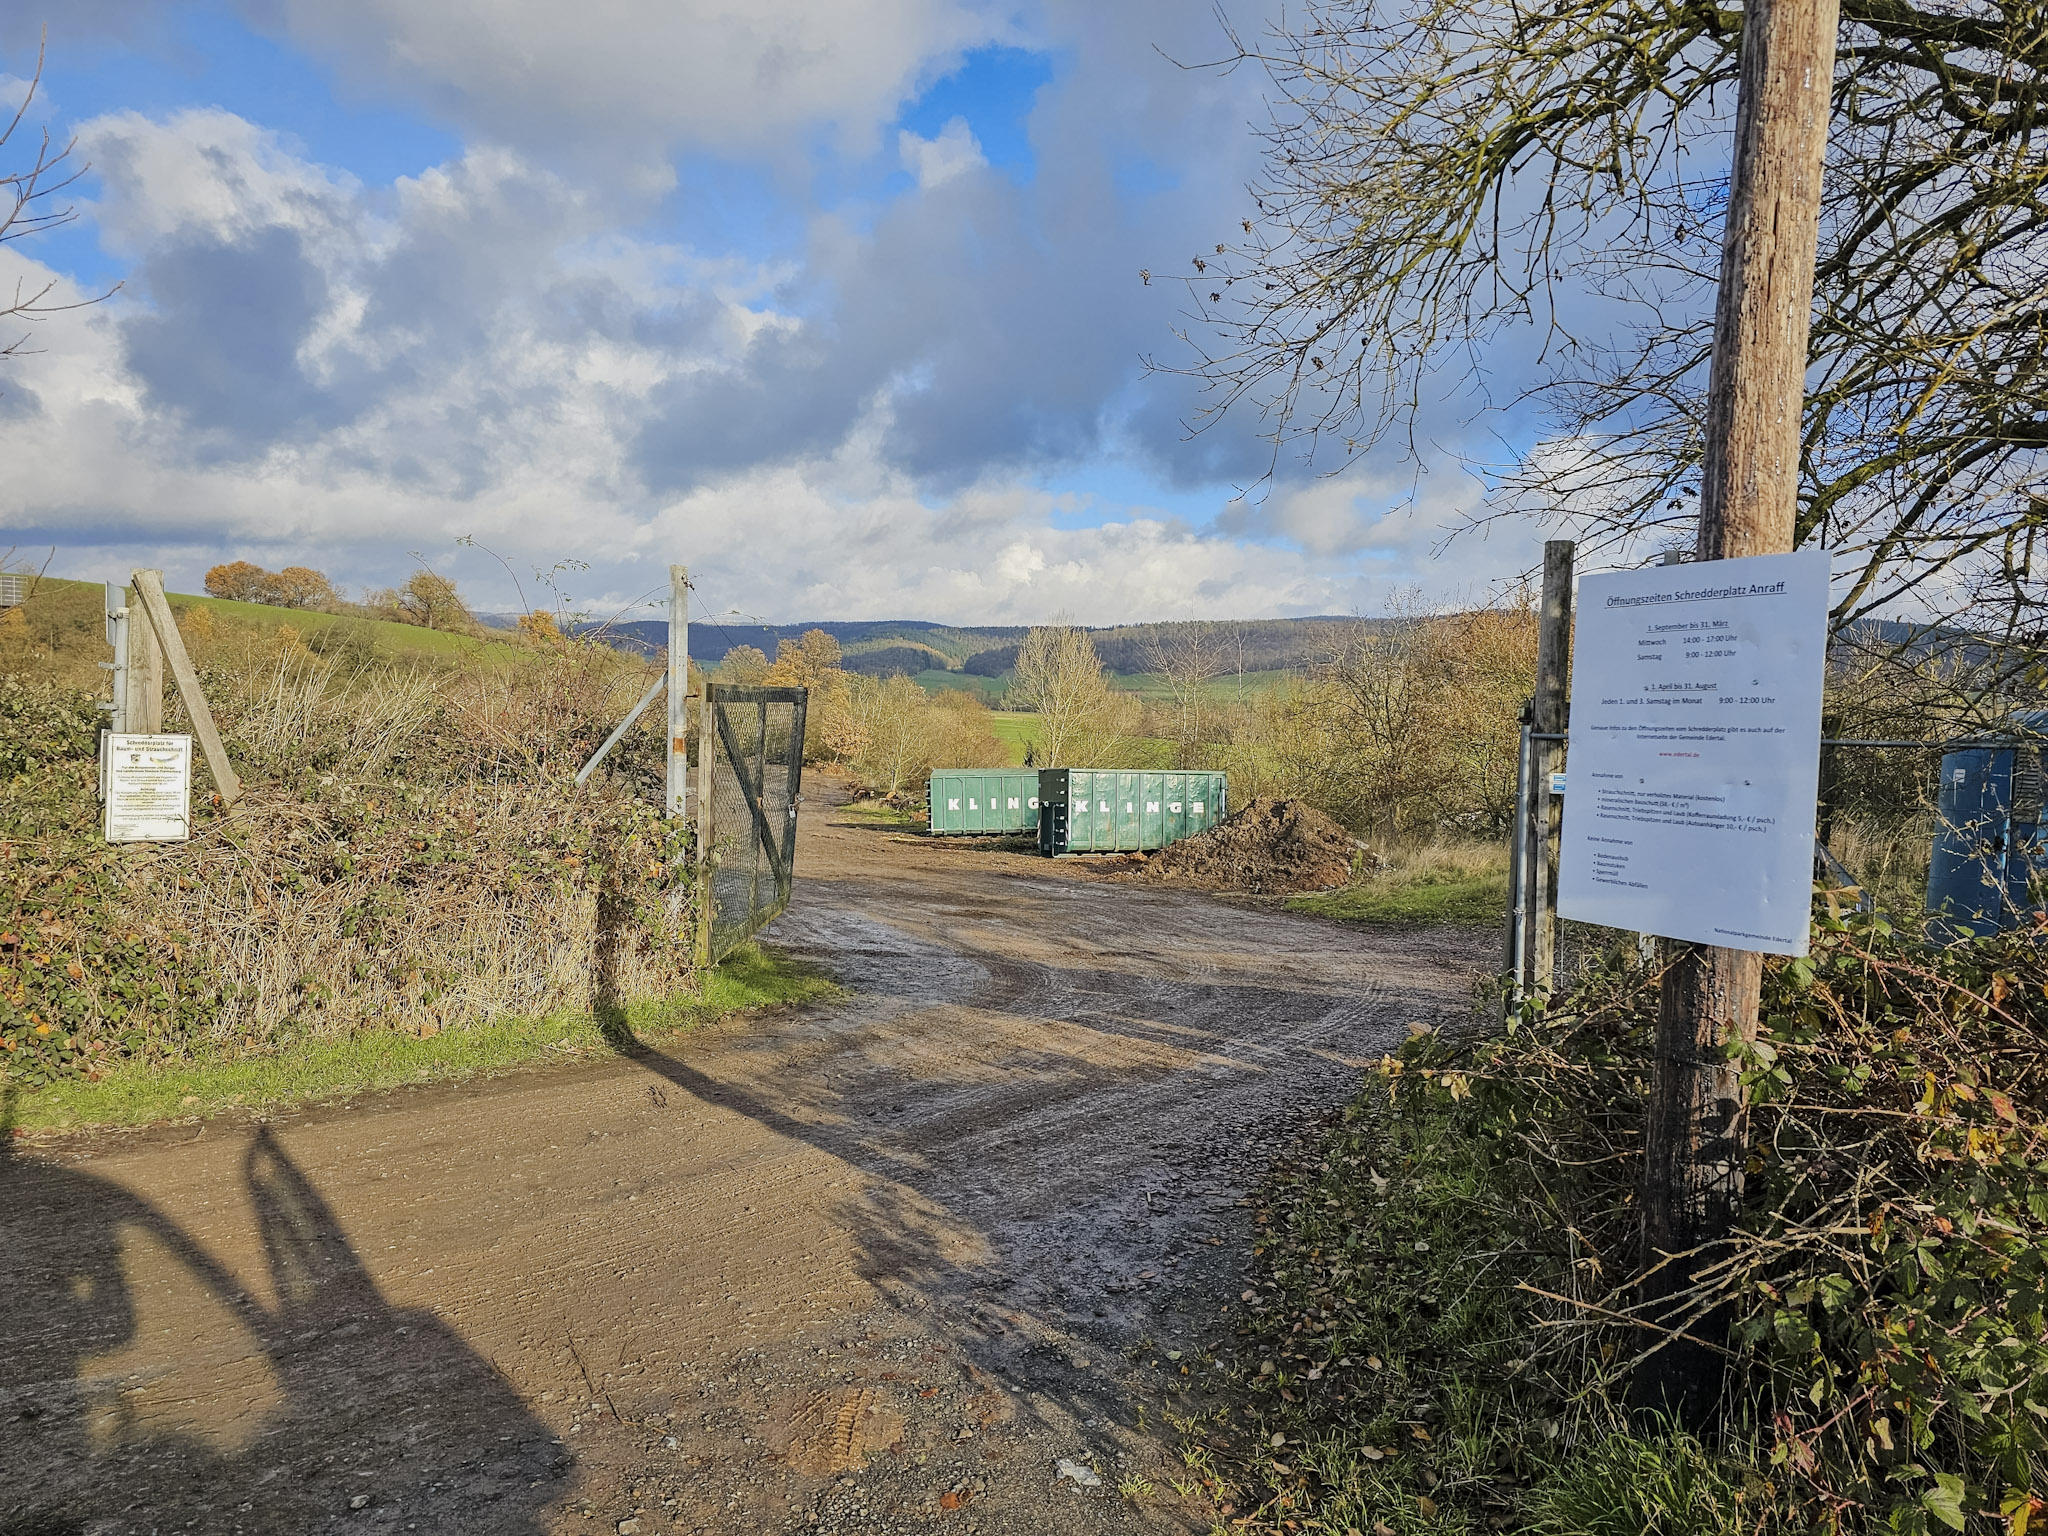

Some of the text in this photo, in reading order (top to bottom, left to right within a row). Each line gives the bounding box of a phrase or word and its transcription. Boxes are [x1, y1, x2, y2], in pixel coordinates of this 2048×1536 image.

[1606, 581, 1785, 607] Öffnungszeiten Schredderplatz Anraff
[1654, 622, 1688, 631] September
[1689, 621, 1699, 629] bis
[1712, 620, 1729, 628] März
[1638, 638, 1667, 646] Mittwoch
[1683, 636, 1701, 644] 14:00
[1706, 635, 1724, 643] 17:00
[1685, 651, 1700, 659] 9:00
[1704, 650, 1723, 658] 12:00
[1658, 683, 1672, 691] April
[1695, 682, 1717, 691] August
[1646, 697, 1671, 706] Samstag
[1727, 726, 1739, 734] gibt
[126, 739, 165, 747] Schredderplatz
[947, 796, 1040, 811] KLING
[1695, 794, 1726, 803] (kostenlos)
[1074, 800, 1205, 814] KLINGE
[1686, 811, 1737, 822] (Kofferraumladung
[1756, 817, 1776, 825] psch.)
[1685, 820, 1726, 830] (Autoanhänger
[1748, 826, 1767, 834] psch.)
[1714, 927, 1793, 944] Nationalparkgemeinde Edertal
